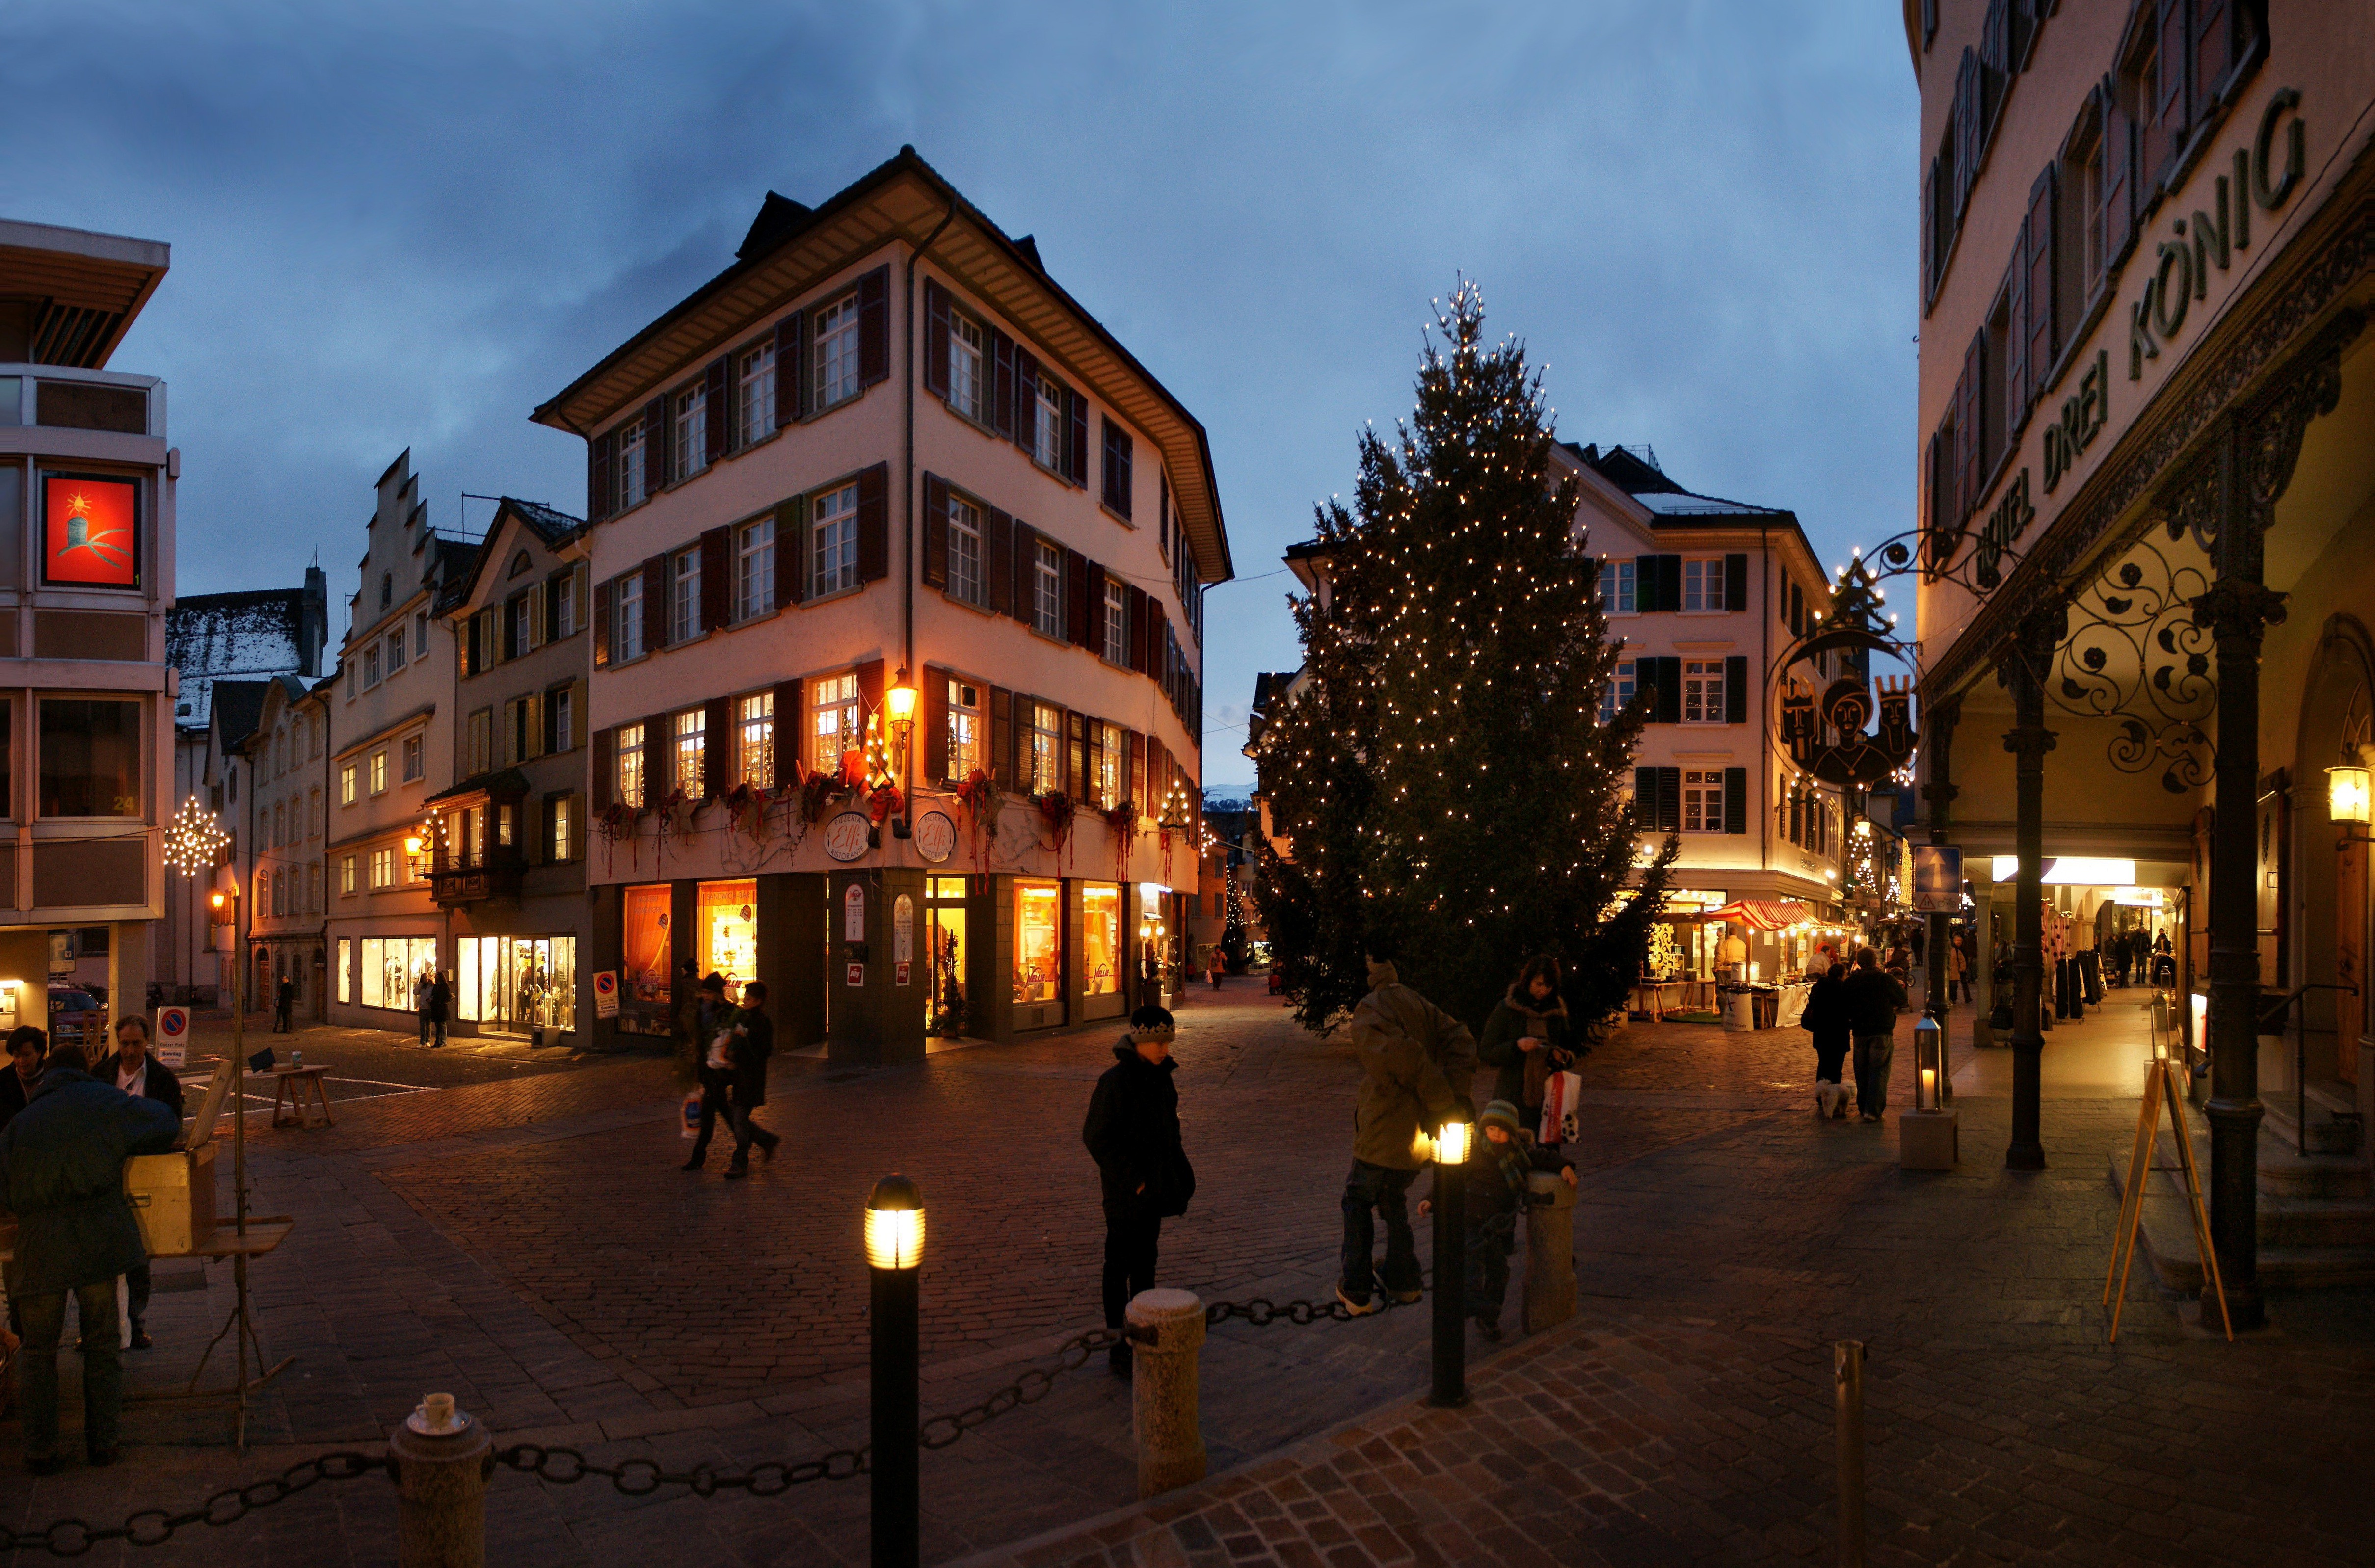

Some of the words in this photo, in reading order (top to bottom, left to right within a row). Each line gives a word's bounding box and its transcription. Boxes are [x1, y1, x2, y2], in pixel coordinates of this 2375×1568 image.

[1976, 466, 2035, 589] HOTEL
[2042, 348, 2108, 495] DREI
[2128, 86, 2306, 381] KÖNIG
[834, 814, 861, 826] PIZZERIA
[924, 814, 946, 825] PIZZERIA
[832, 824, 860, 852] Elfi
[922, 823, 946, 852] Elfi
[830, 844, 865, 859] RISTORANTE
[921, 845, 949, 859] RISTORANTE
[707, 891, 750, 901] SANDWICH-BAR
